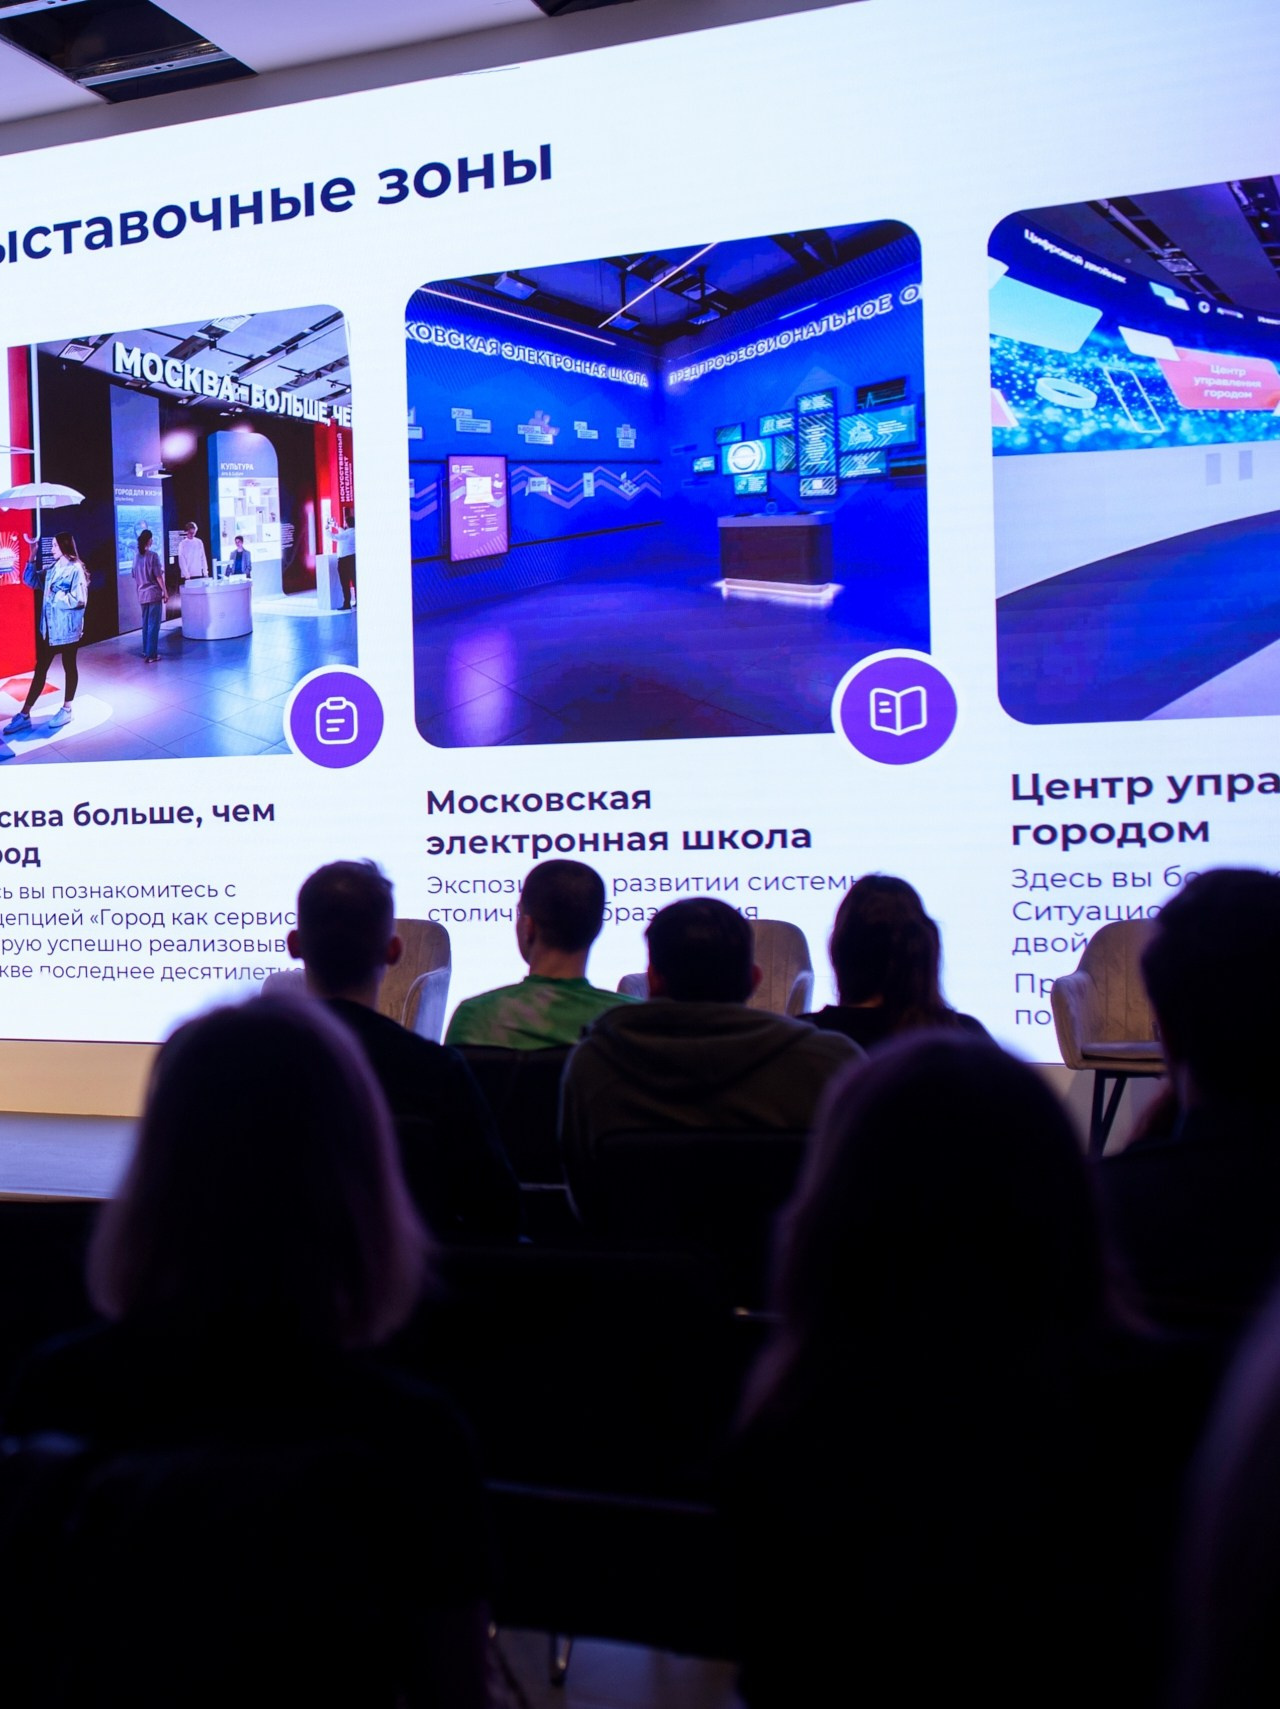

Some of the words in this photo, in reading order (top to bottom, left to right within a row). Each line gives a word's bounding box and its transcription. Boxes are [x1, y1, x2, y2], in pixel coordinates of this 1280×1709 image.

[377, 142, 553, 206] зоны
[669, 294, 894, 386] ПРЕДПРОФЕССИОНАЛЬНОЕ
[114, 341, 237, 402] МОСКВА
[501, 343, 609, 379] ЭЛЕКТРОННАЯ
[608, 366, 650, 388] ШКОЛА
[1210, 364, 1246, 378] Центр
[1204, 388, 1252, 400] городом
[426, 788, 652, 816] Московская
[1011, 773, 1155, 806] Центр
[1166, 772, 1280, 805] упра
[73, 801, 203, 829] больше,
[212, 802, 276, 823] чем
[426, 830, 669, 859] электронная
[682, 826, 813, 851] школа
[1012, 820, 1210, 852] городом
[19, 885, 46, 900] вы
[52, 884, 219, 900] познакомитесь
[224, 883, 237, 898] с
[613, 876, 739, 896] развитии
[1011, 868, 1103, 892] Здесь
[1112, 871, 1152, 888] вы
[90, 908, 166, 930] «Город
[172, 911, 209, 926] как
[47, 938, 143, 956] успешно
[39, 964, 155, 982] последнее
